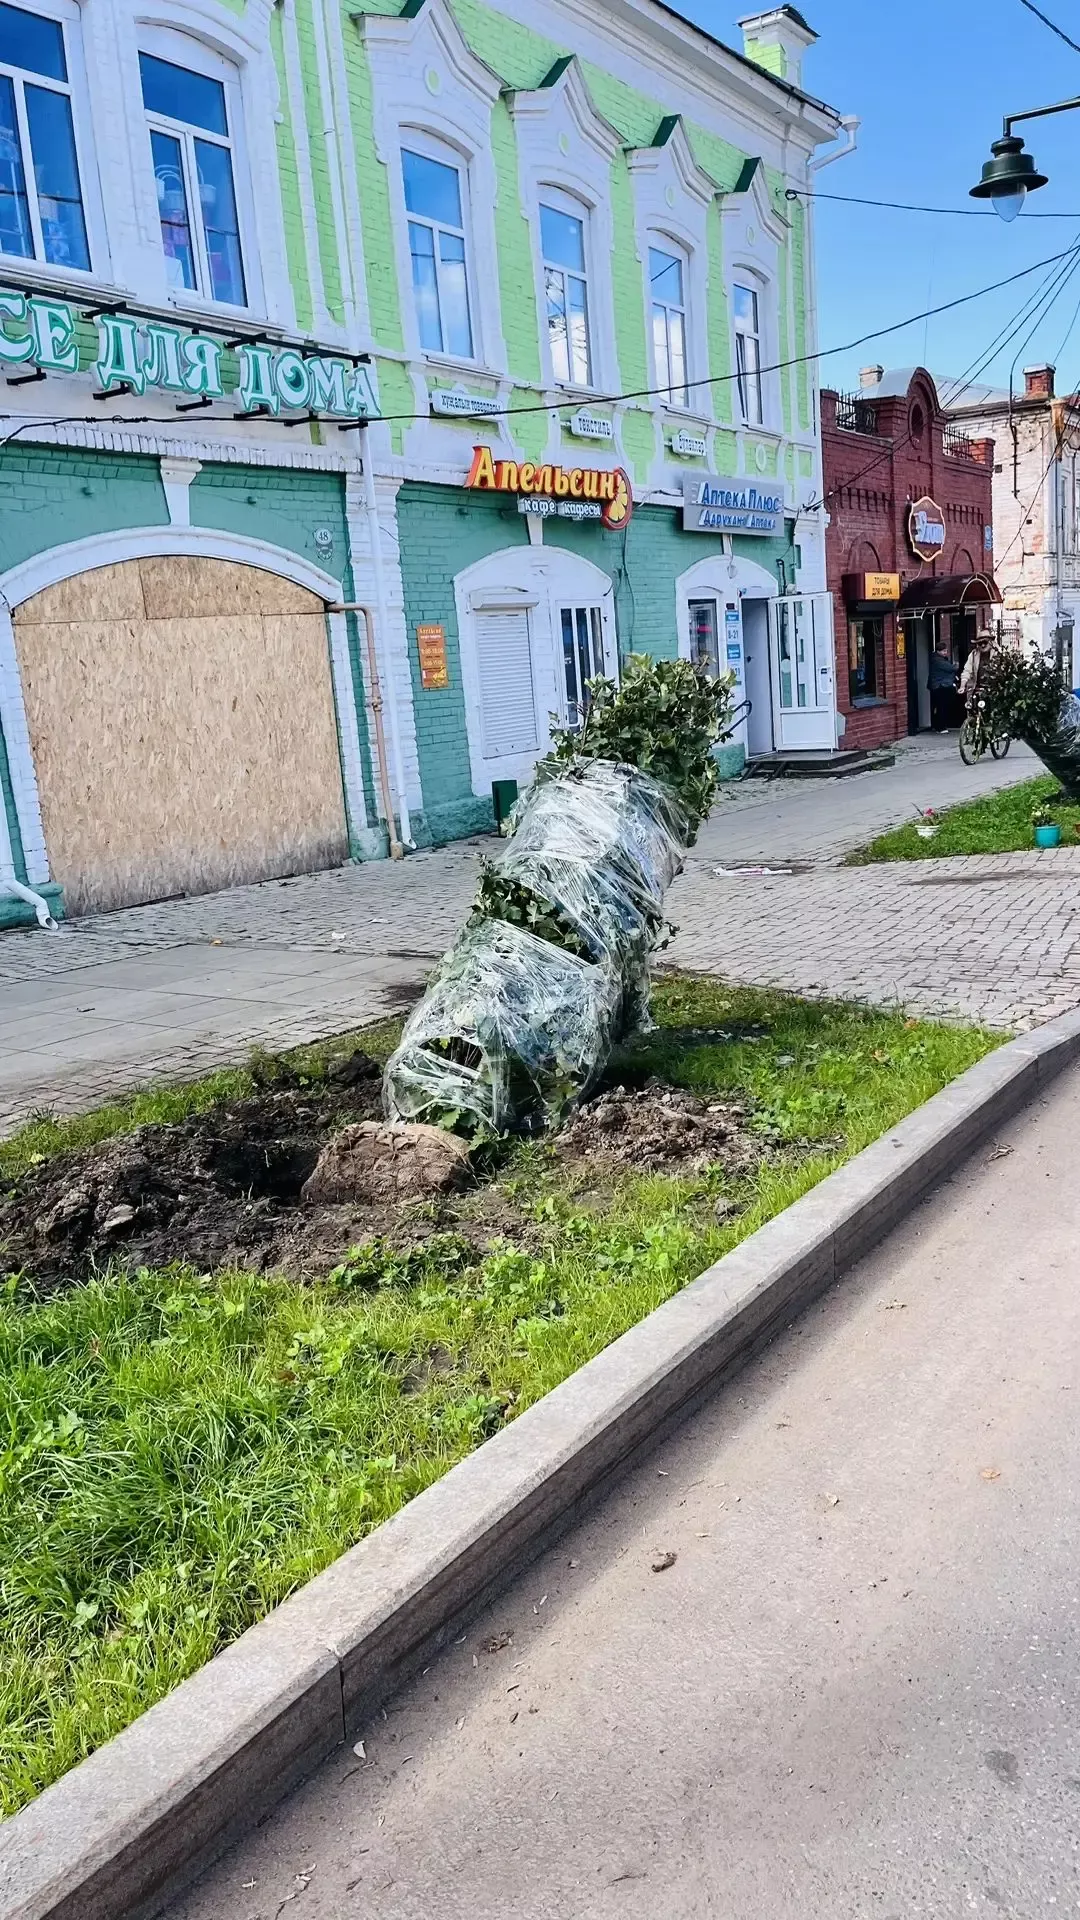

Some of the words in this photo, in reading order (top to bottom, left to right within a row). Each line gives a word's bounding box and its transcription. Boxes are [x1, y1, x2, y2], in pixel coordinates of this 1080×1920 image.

[95, 315, 225, 396] ДЛЯ
[238, 344, 381, 417] ДОМА
[467, 446, 617, 500] Апельсин
[522, 498, 556, 517] кафе
[561, 501, 602, 519] кафесы
[319, 531, 329, 541] 48
